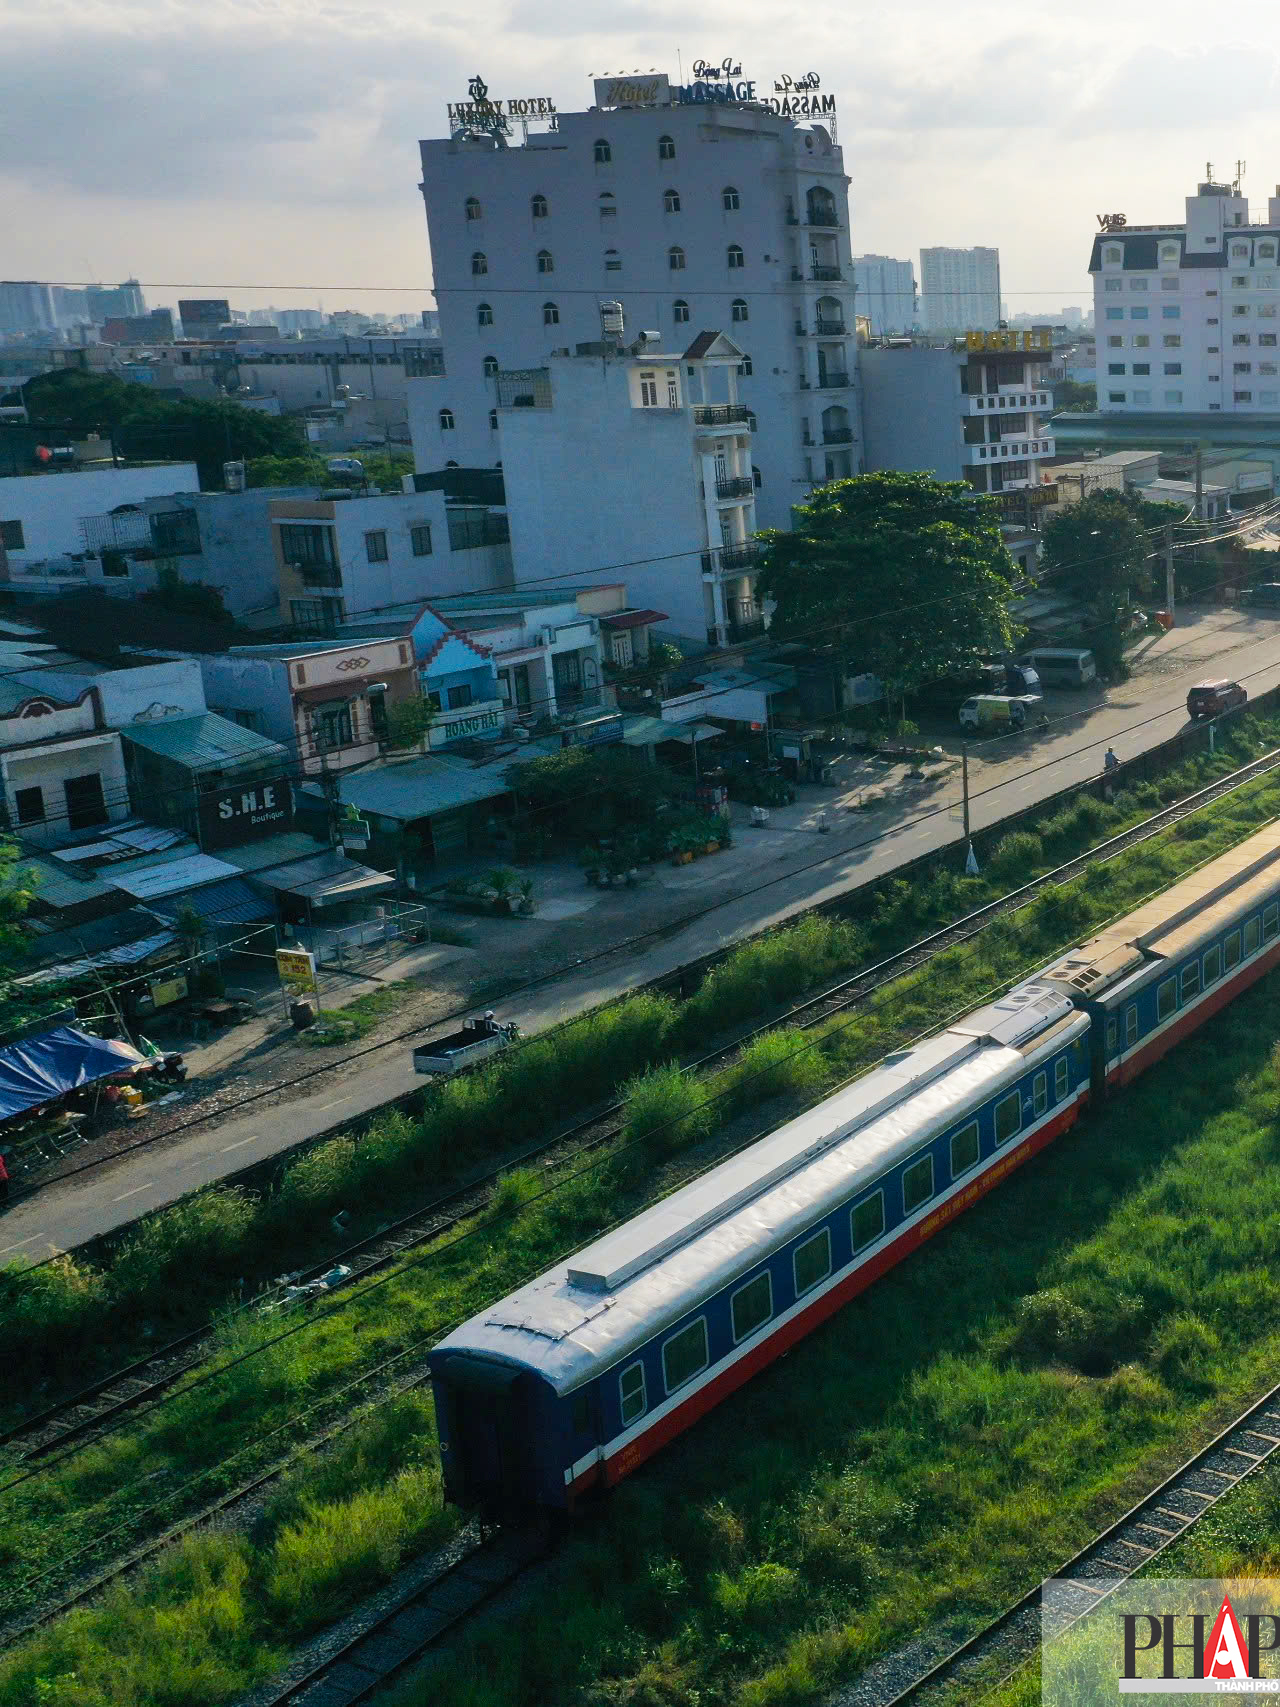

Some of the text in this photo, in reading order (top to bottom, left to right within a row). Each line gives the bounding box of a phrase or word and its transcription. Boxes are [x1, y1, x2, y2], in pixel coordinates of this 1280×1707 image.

[679, 80, 757, 103] MASSAGE
[447, 97, 556, 119] LUXURY HOTEL
[218, 786, 277, 819] S.H.E
[251, 809, 285, 825] Boutique
